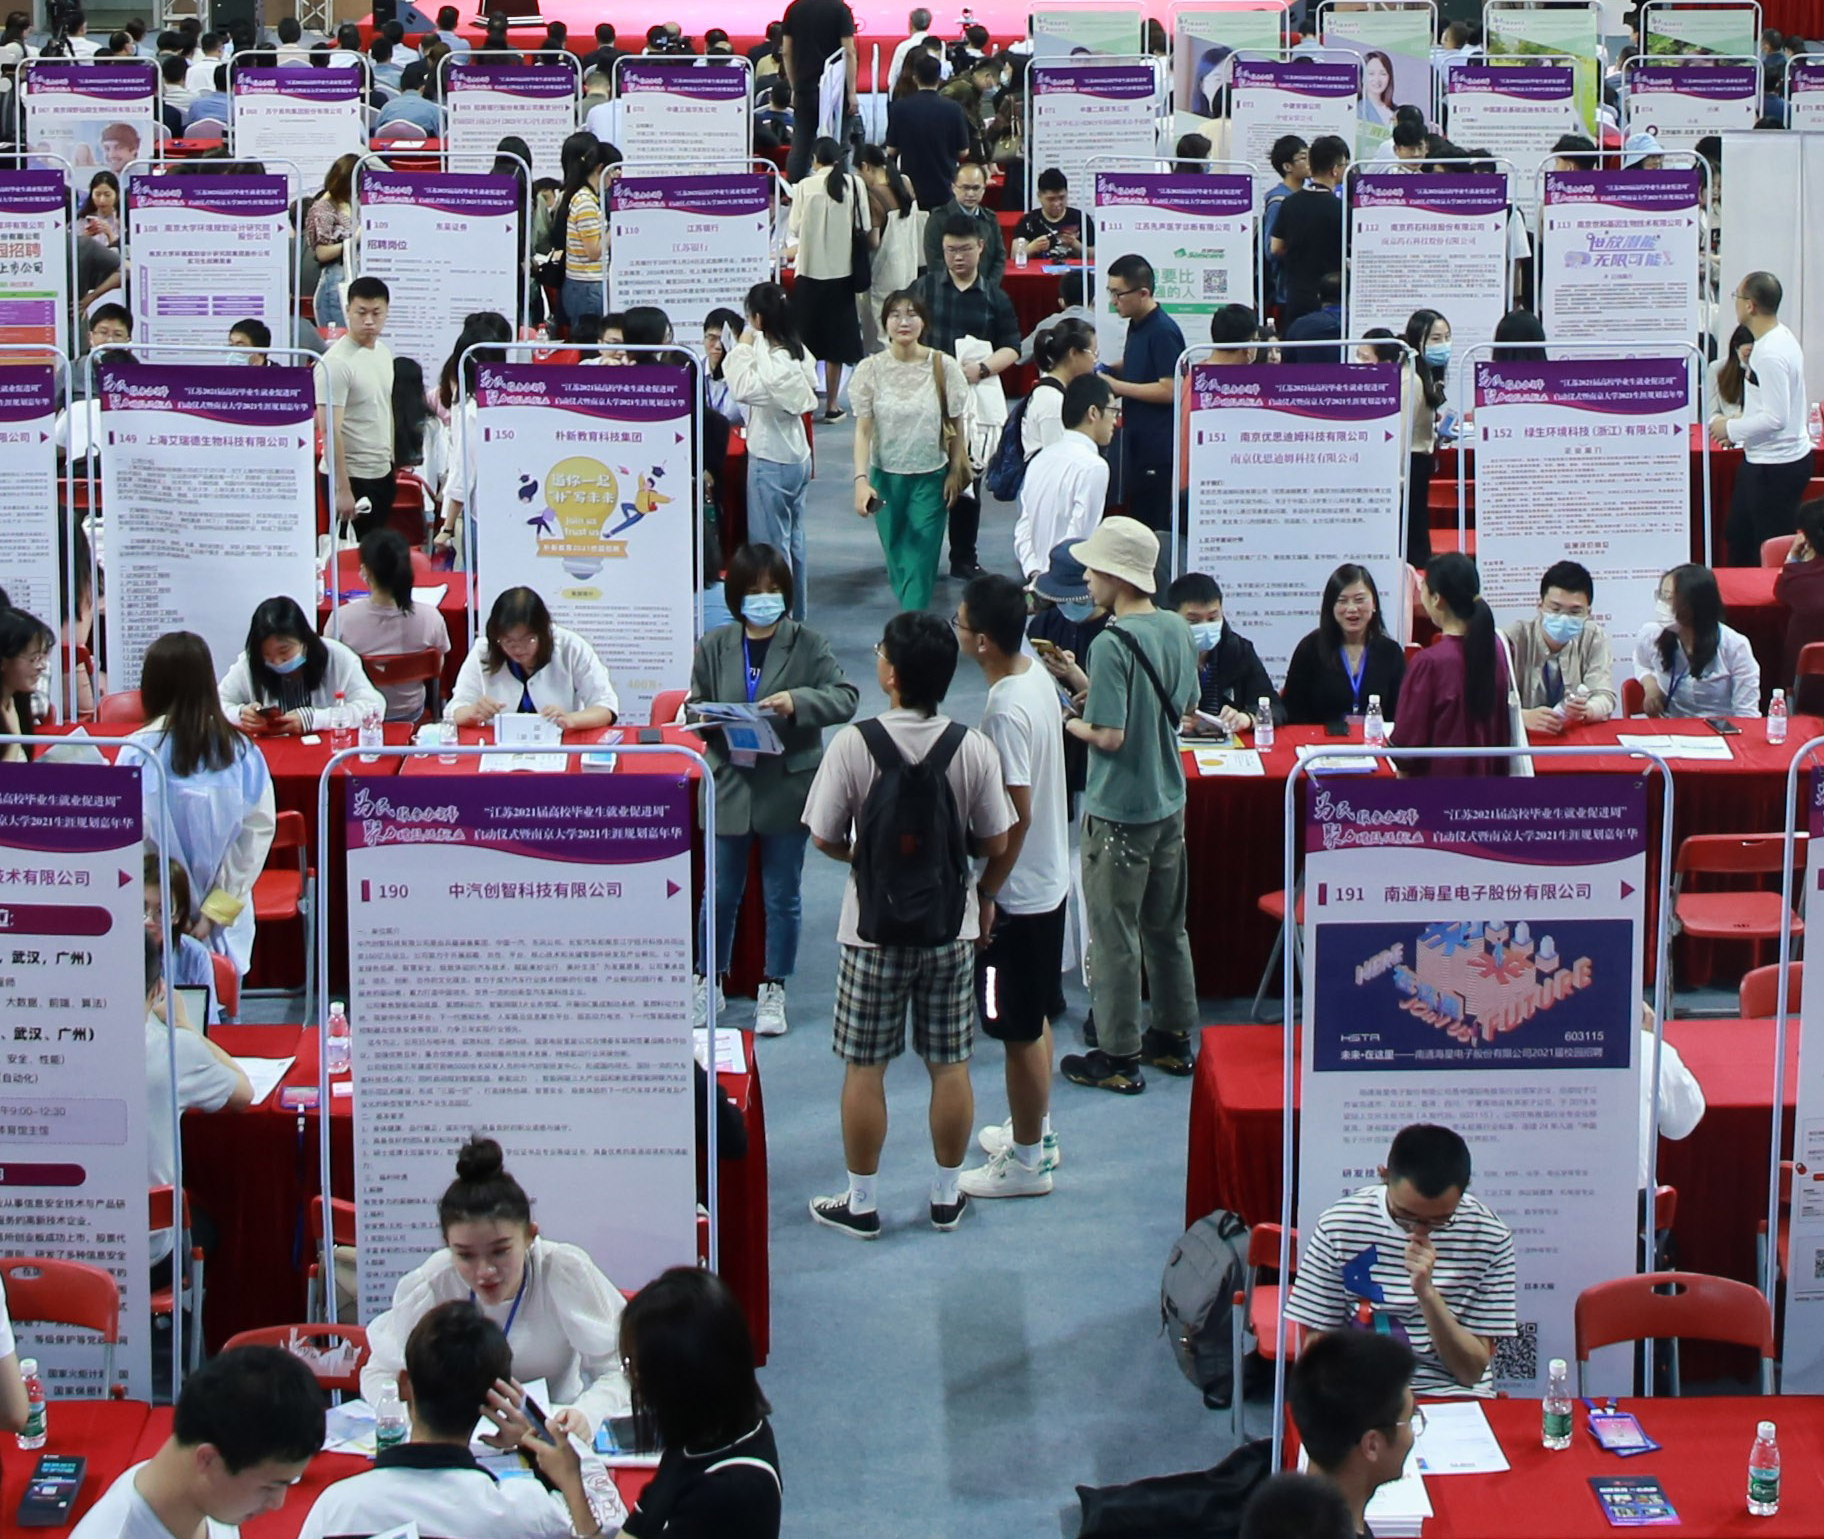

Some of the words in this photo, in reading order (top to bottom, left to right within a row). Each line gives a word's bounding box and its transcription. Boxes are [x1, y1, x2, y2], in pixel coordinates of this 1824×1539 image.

[120, 434, 138, 443] 149
[496, 430, 514, 439] 150
[556, 431, 642, 443] 朴新教育科技集团
[1208, 432, 1228, 442] 151
[1240, 430, 1368, 442] 南京优思迪姆科技有限公司
[1493, 427, 1512, 438] 152
[379, 884, 408, 899] 190
[448, 882, 622, 899] 中汽创智科技有限公司
[1335, 887, 1364, 901] 191
[1384, 884, 1591, 903] 南通海星电子股份有限公司
[1565, 1031, 1604, 1041] 603115
